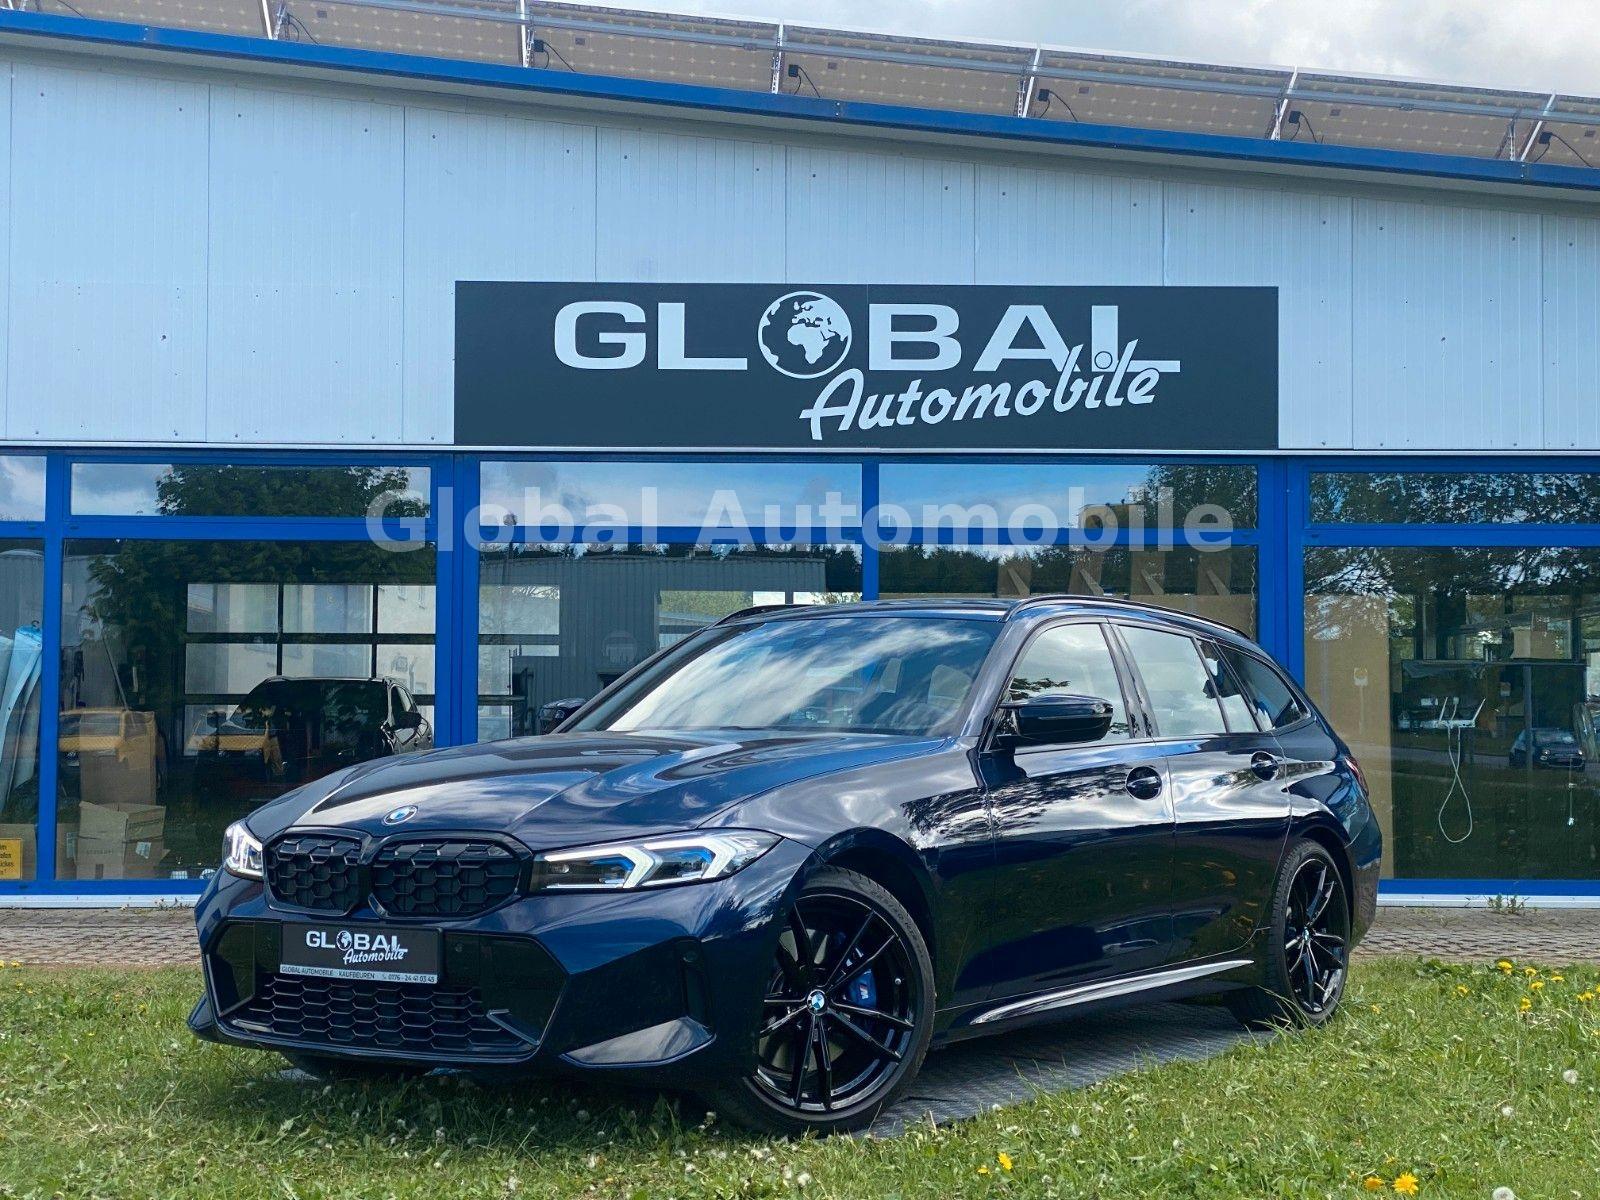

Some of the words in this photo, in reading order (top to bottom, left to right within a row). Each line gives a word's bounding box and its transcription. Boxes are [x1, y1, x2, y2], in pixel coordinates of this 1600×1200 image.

[554, 290, 1181, 379] GLOBAL
[799, 339, 1160, 441] Automobile
[306, 930, 408, 952] GLOBAL
[343, 944, 405, 965] Automobile
[302, 968, 333, 976] AUTOMOBILE
[339, 971, 375, 979] KAUFBEUREN
